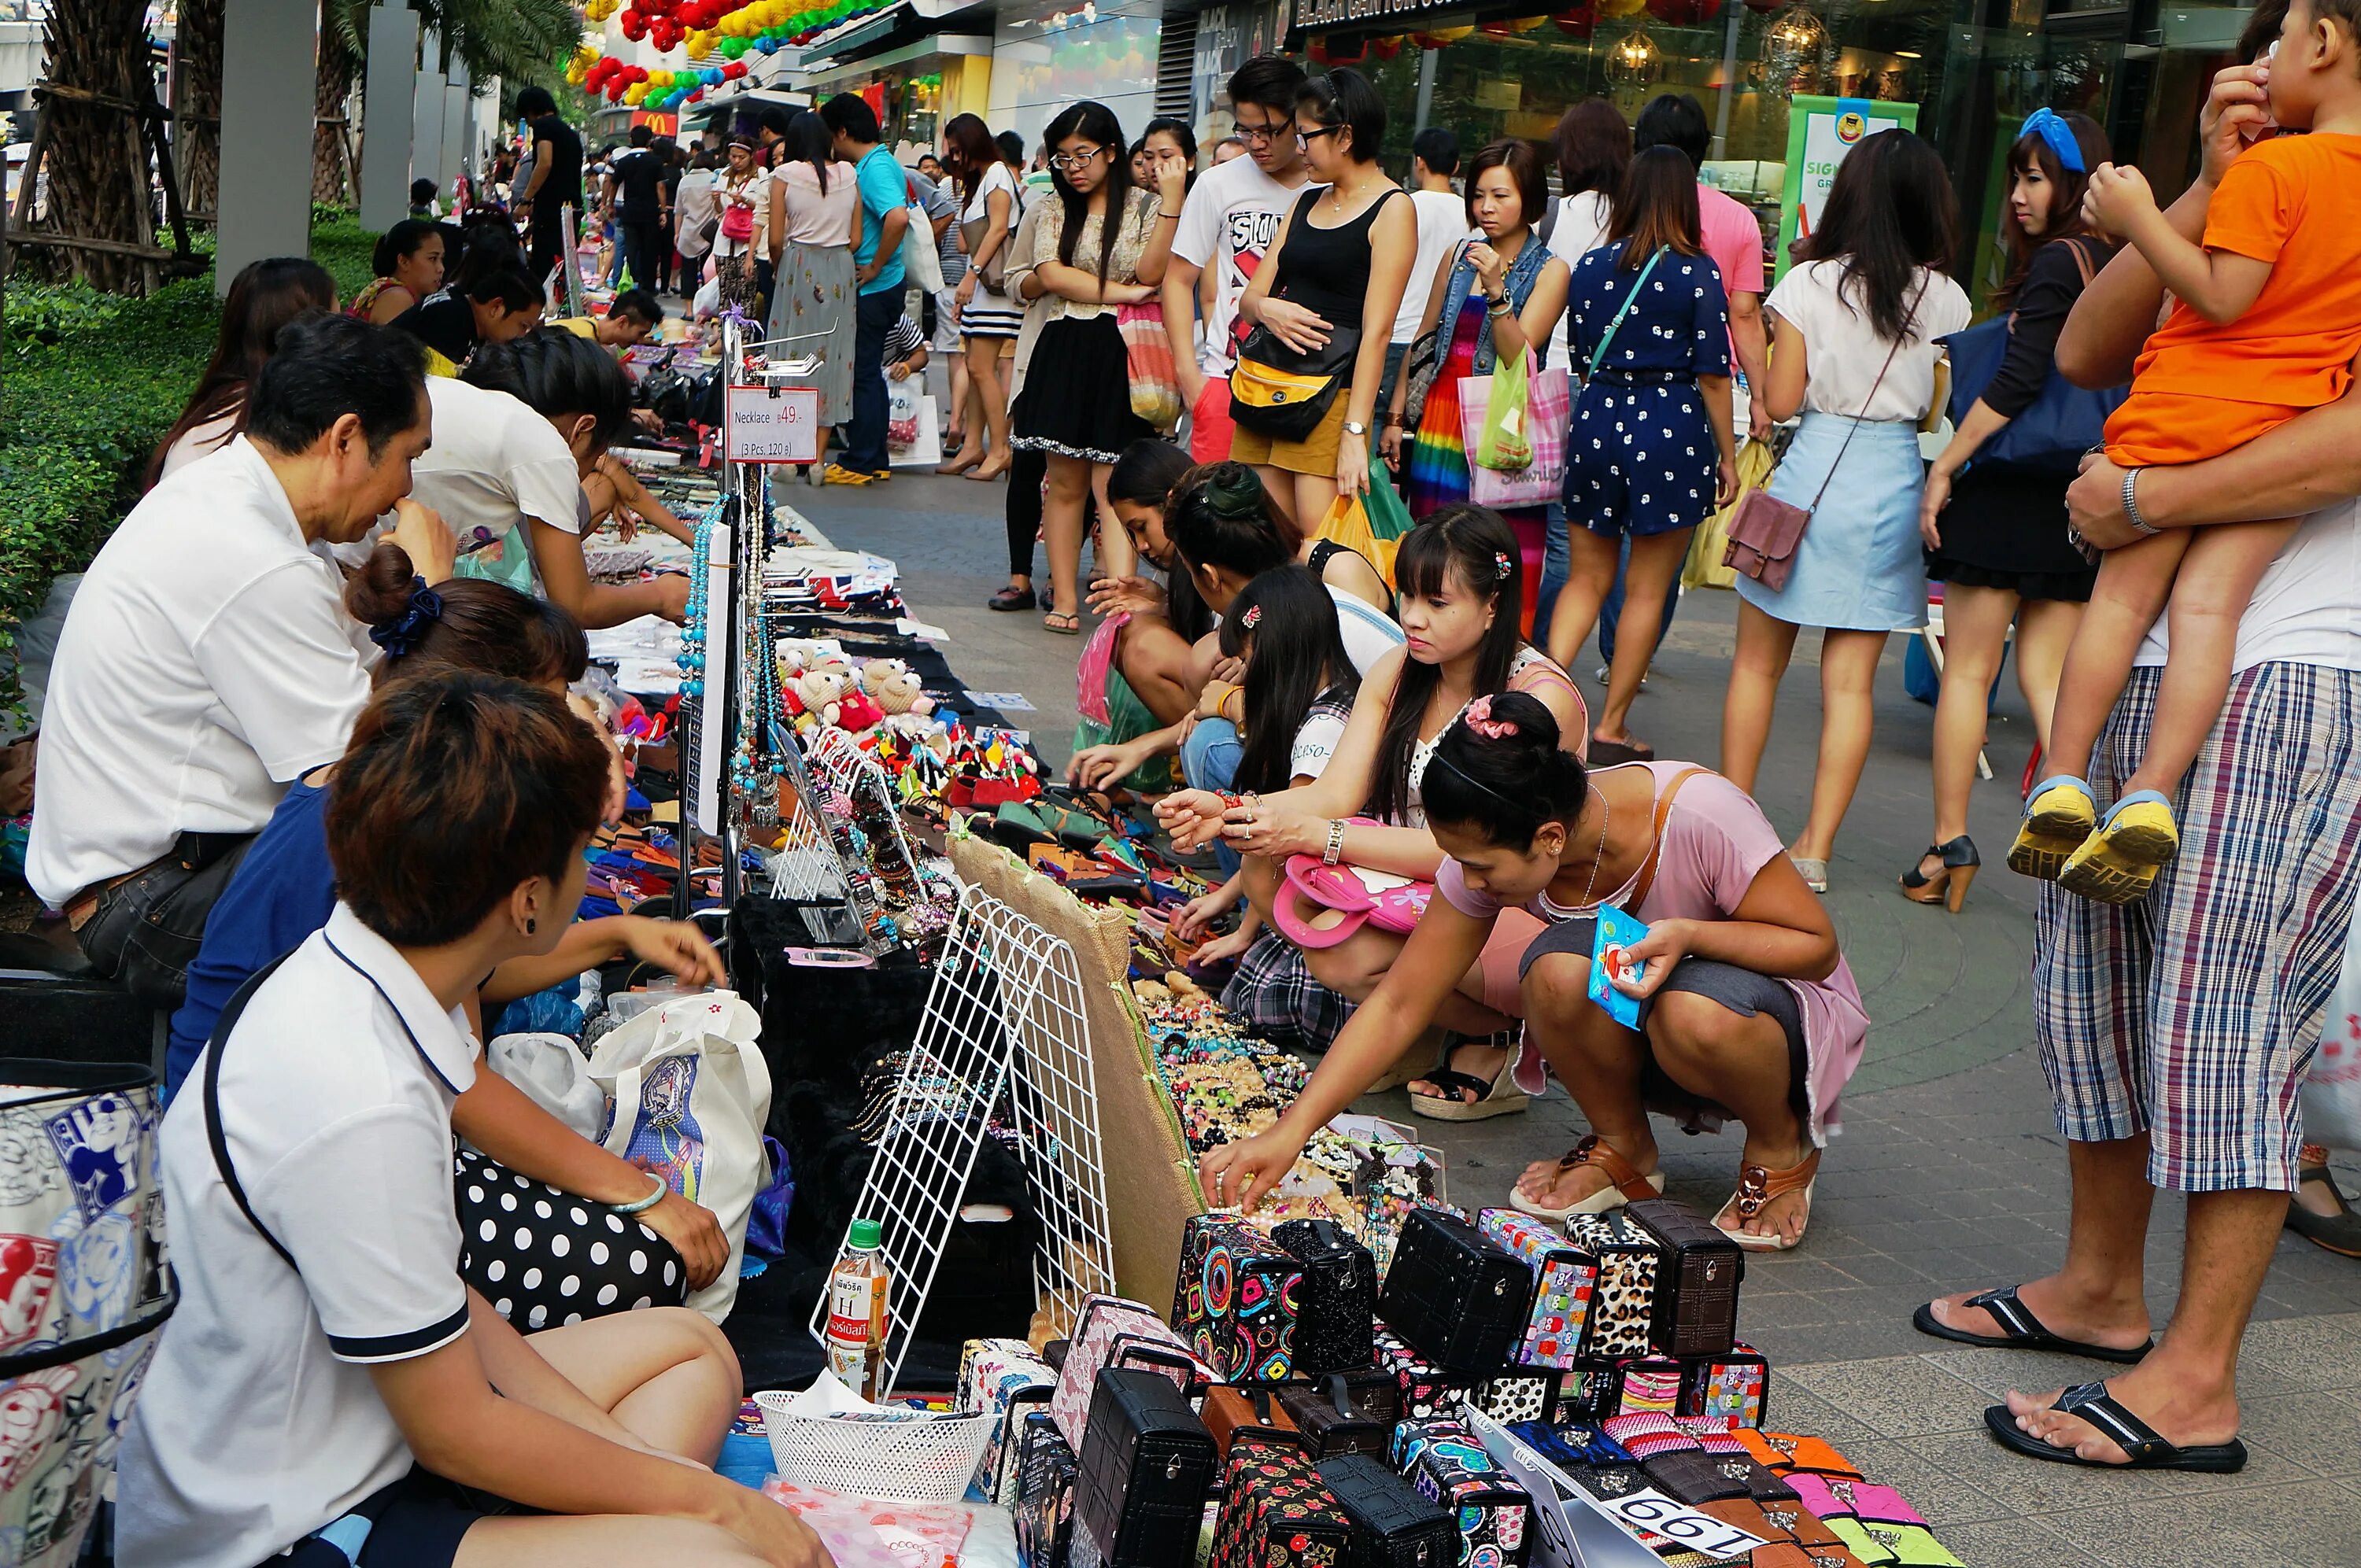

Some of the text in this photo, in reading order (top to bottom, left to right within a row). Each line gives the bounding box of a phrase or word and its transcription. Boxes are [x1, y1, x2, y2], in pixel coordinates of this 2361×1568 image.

[735, 411, 770, 423] Necklace
[741, 442, 749, 457] (3
[751, 444, 766, 456] Pcs.
[768, 443, 783, 456] 120
[838, 1296, 853, 1317] H
[1620, 1498, 1765, 1555] 199
